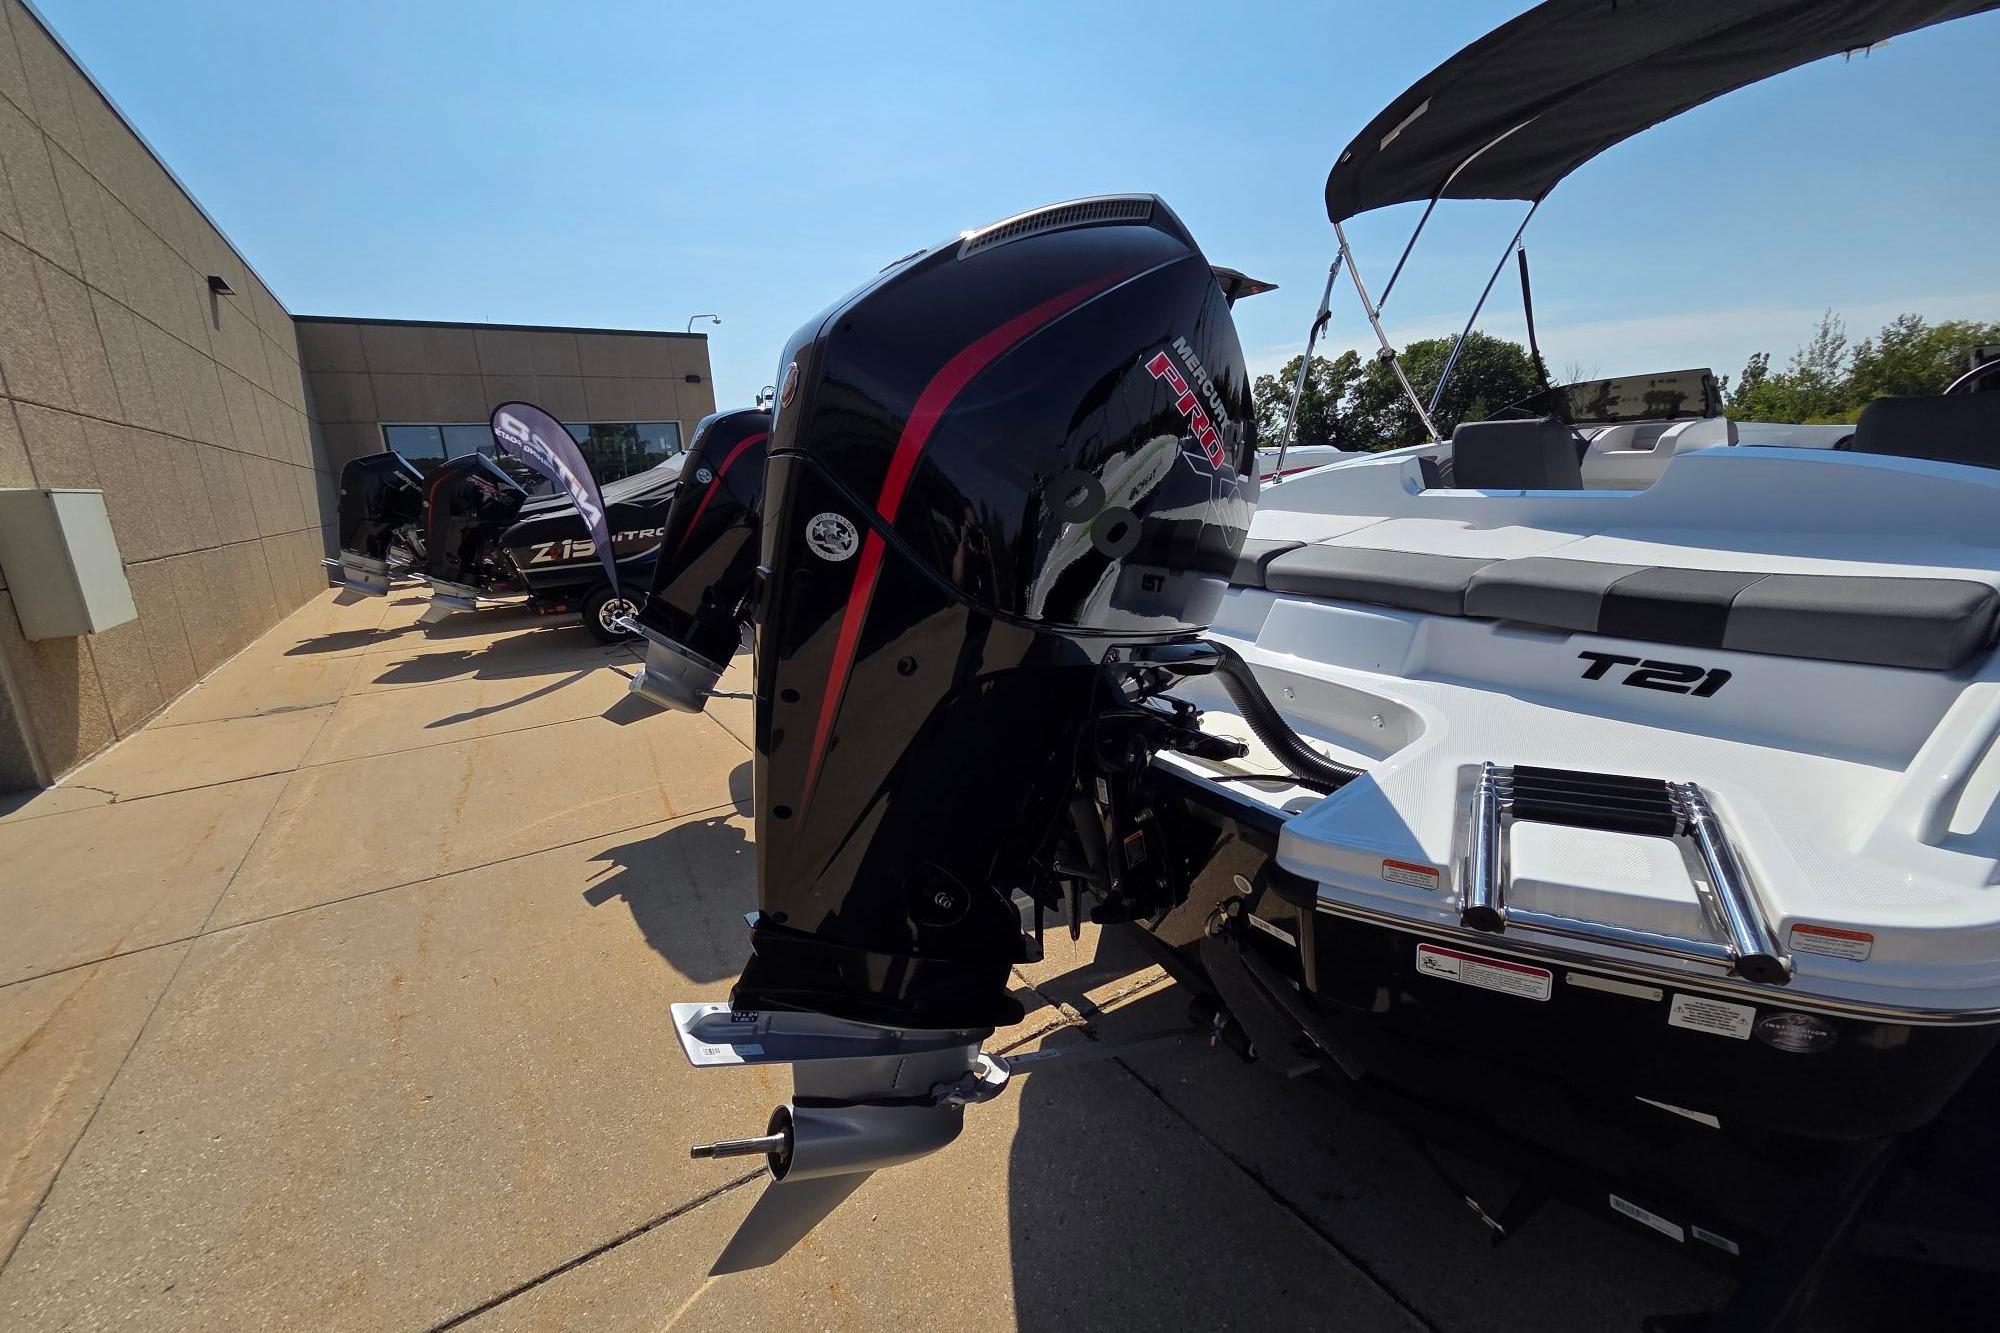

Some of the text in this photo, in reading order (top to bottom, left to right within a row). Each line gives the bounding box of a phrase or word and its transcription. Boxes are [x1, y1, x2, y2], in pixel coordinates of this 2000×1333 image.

[1145, 351, 1226, 470] PRO
[1171, 336, 1230, 430] MERCURY
[1578, 651, 1732, 698] T21
[1765, 1022, 1828, 1037] INSTTION
